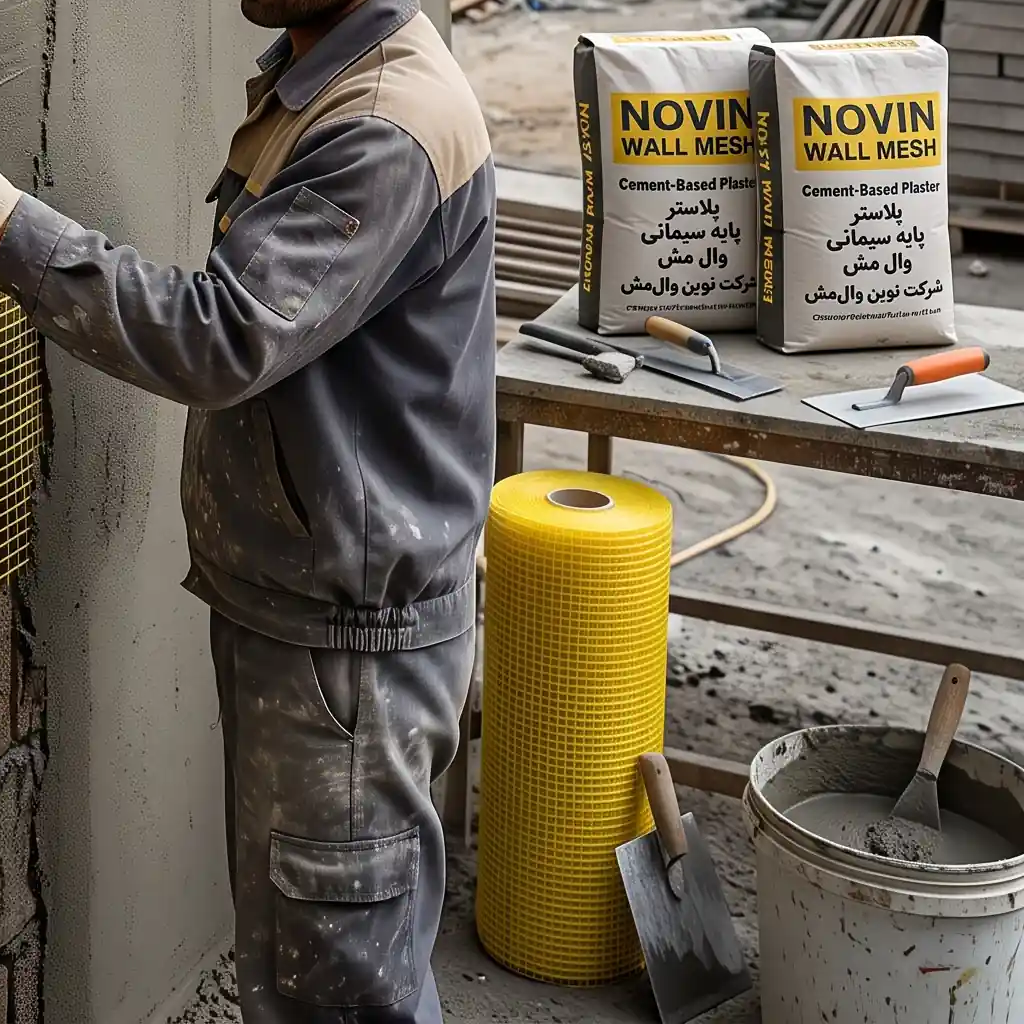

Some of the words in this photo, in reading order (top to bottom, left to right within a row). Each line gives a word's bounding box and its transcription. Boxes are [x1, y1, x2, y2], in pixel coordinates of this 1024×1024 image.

[621, 97, 753, 131] NOVIN
[802, 100, 935, 136] NOVIN
[621, 137, 688, 156] WALL
[695, 135, 755, 155] MESH
[804, 142, 870, 161] WALL
[877, 138, 937, 160] MESH
[619, 176, 717, 192] Cement-Based
[719, 176, 757, 190] Plaste
[802, 182, 898, 197] Cement-Based
[902, 181, 941, 195] Plaster
[665, 198, 720, 222] پلاستر
[849, 202, 903, 226] پلاستر
[641, 223, 706, 245] سیمانی
[710, 221, 741, 245] پایه
[826, 229, 891, 251] سیمانی
[896, 226, 925, 249] پایه
[658, 247, 694, 269] مش
[698, 247, 728, 268] وال
[843, 254, 880, 276] مش
[884, 252, 913, 274] وال
[681, 277, 716, 296] نوین
[867, 284, 900, 304] نوین
[903, 279, 943, 300] شرکت
